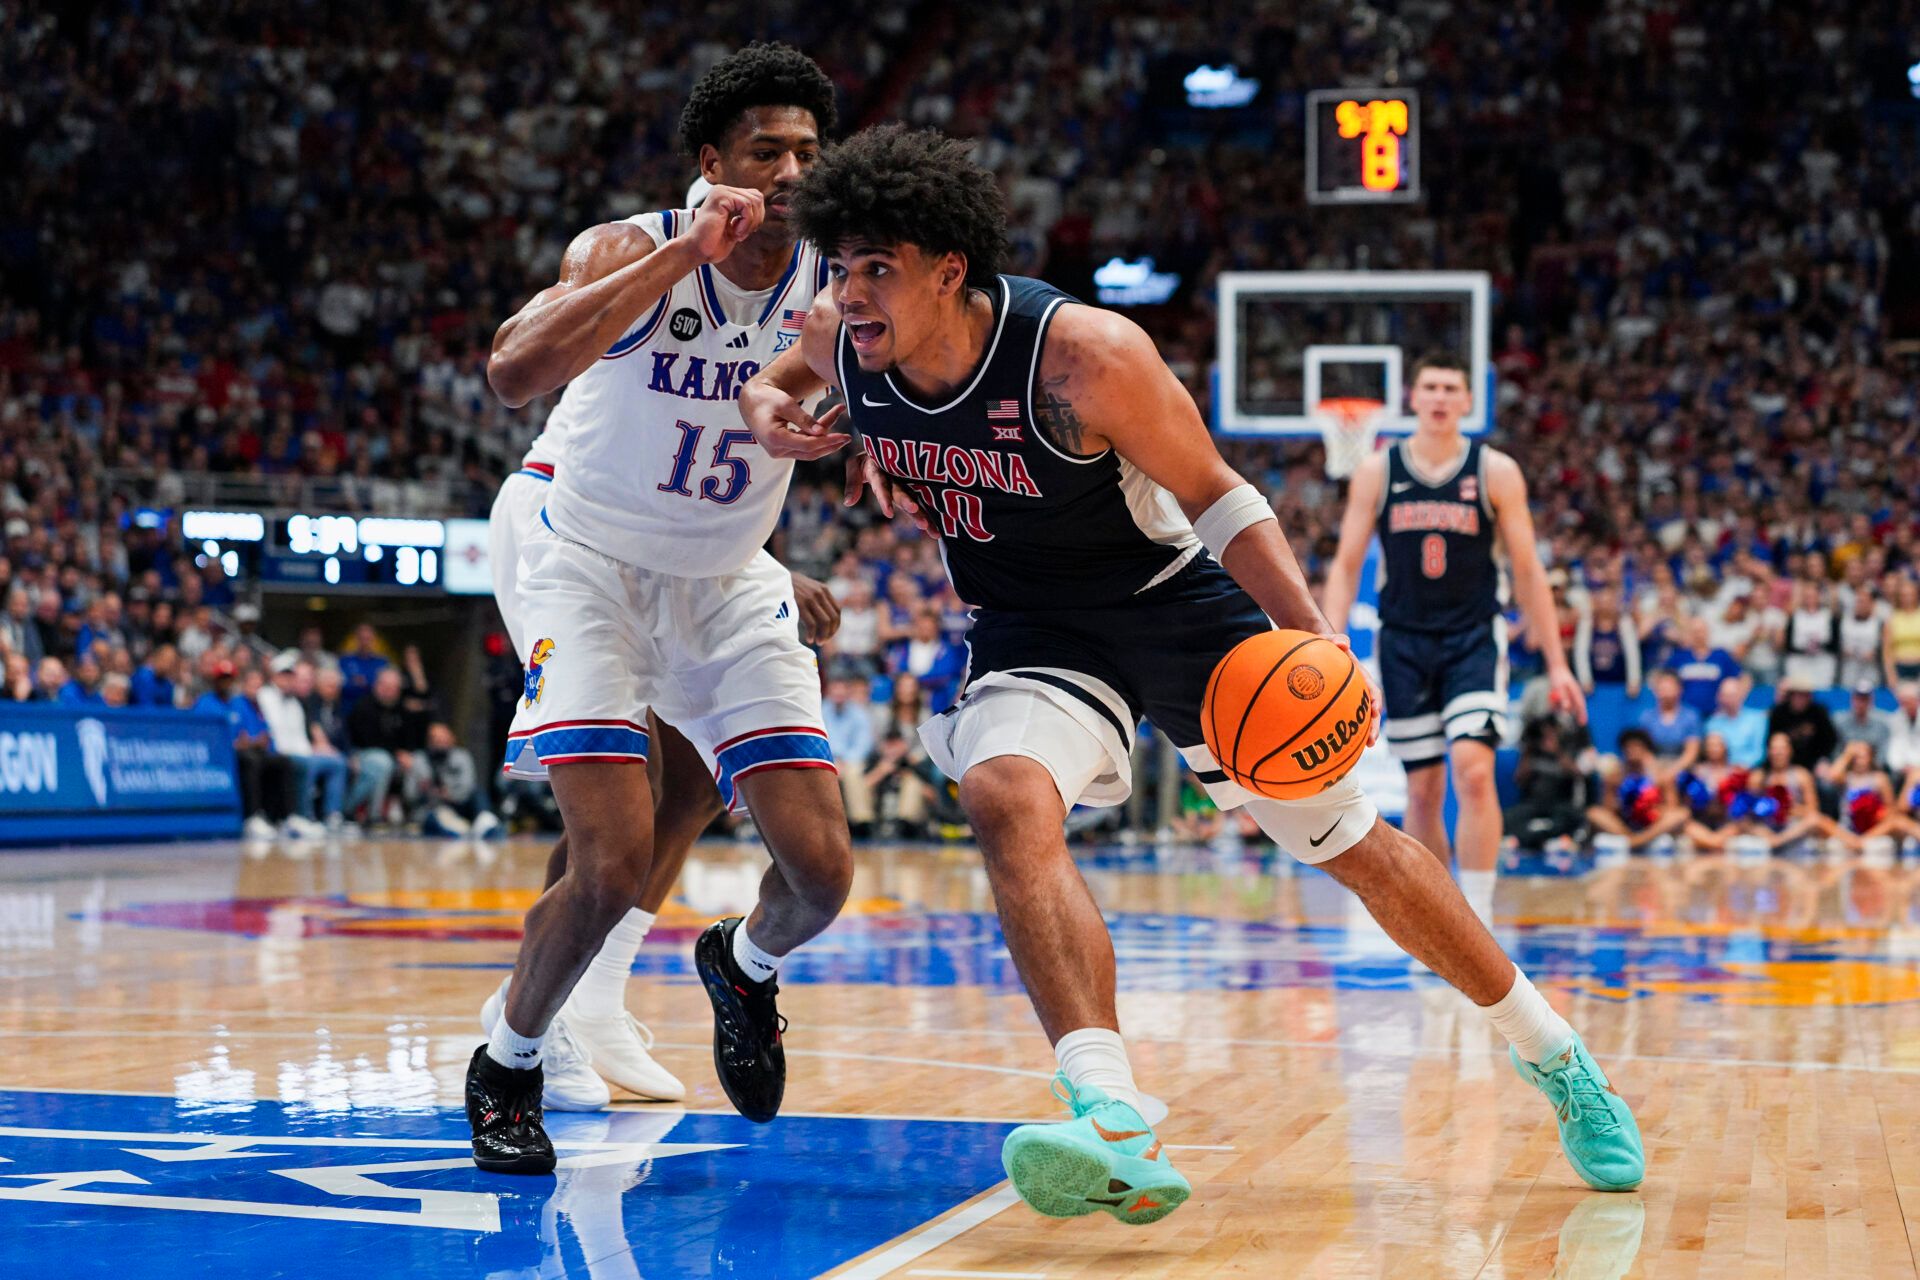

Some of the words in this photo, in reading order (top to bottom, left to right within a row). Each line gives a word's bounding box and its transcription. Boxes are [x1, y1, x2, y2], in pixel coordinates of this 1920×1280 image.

[672, 314, 699, 336] SW
[647, 351, 761, 401] KANS
[657, 419, 757, 505] 15
[861, 433, 1043, 498] ARIZONA
[909, 483, 995, 542] 10
[1422, 533, 1447, 579] 8
[1290, 689, 1370, 771] Wilson
